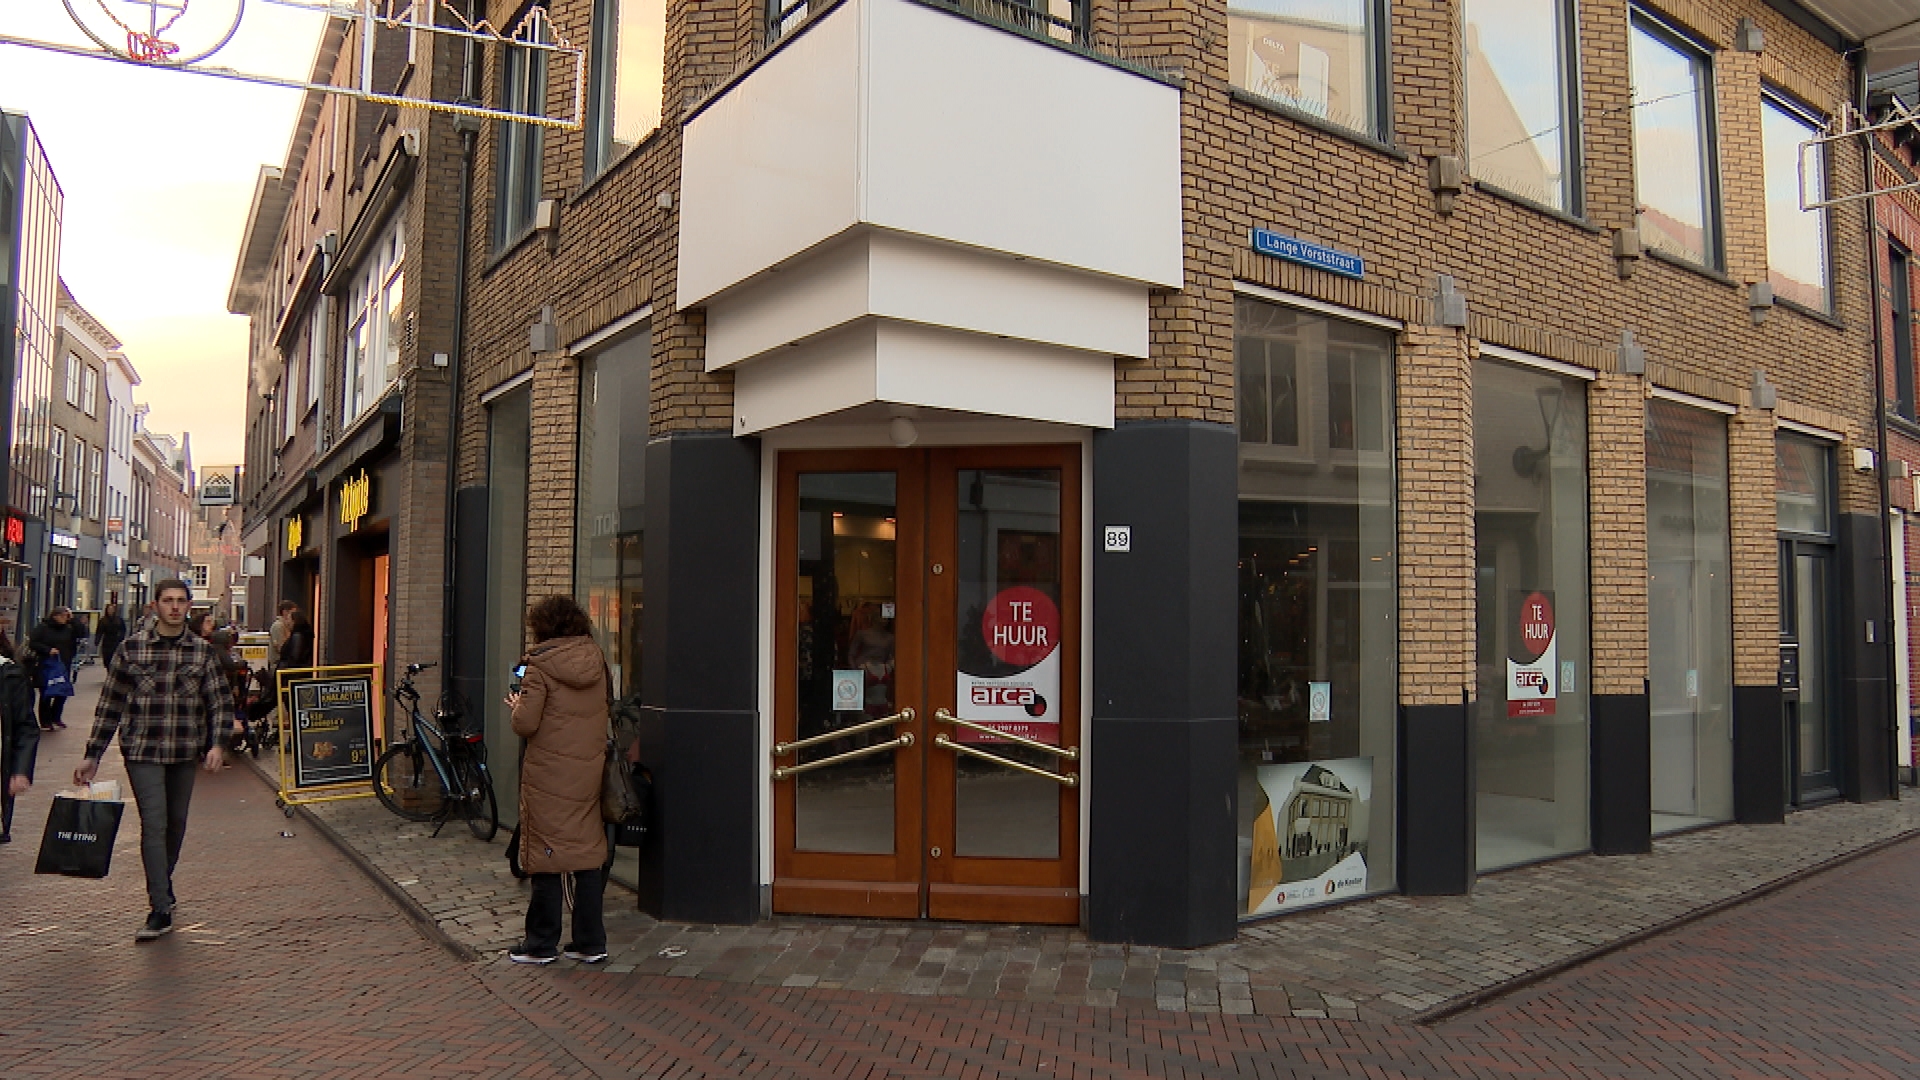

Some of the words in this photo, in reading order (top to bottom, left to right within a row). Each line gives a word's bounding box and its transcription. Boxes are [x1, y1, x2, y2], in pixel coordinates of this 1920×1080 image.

[1263, 37, 1285, 54] DELTA
[1266, 233, 1298, 256] Lange
[1300, 244, 1355, 270] Vorststraat
[1107, 531, 1128, 547] 89
[1009, 601, 1032, 622] TE
[1531, 605, 1542, 621] TE
[993, 625, 1048, 646] HUUR
[1525, 623, 1549, 639] HUUR
[1516, 672, 1544, 686] arca
[972, 687, 1035, 705] arca
[300, 712, 310, 728] 5
[57, 831, 73, 841] THE
